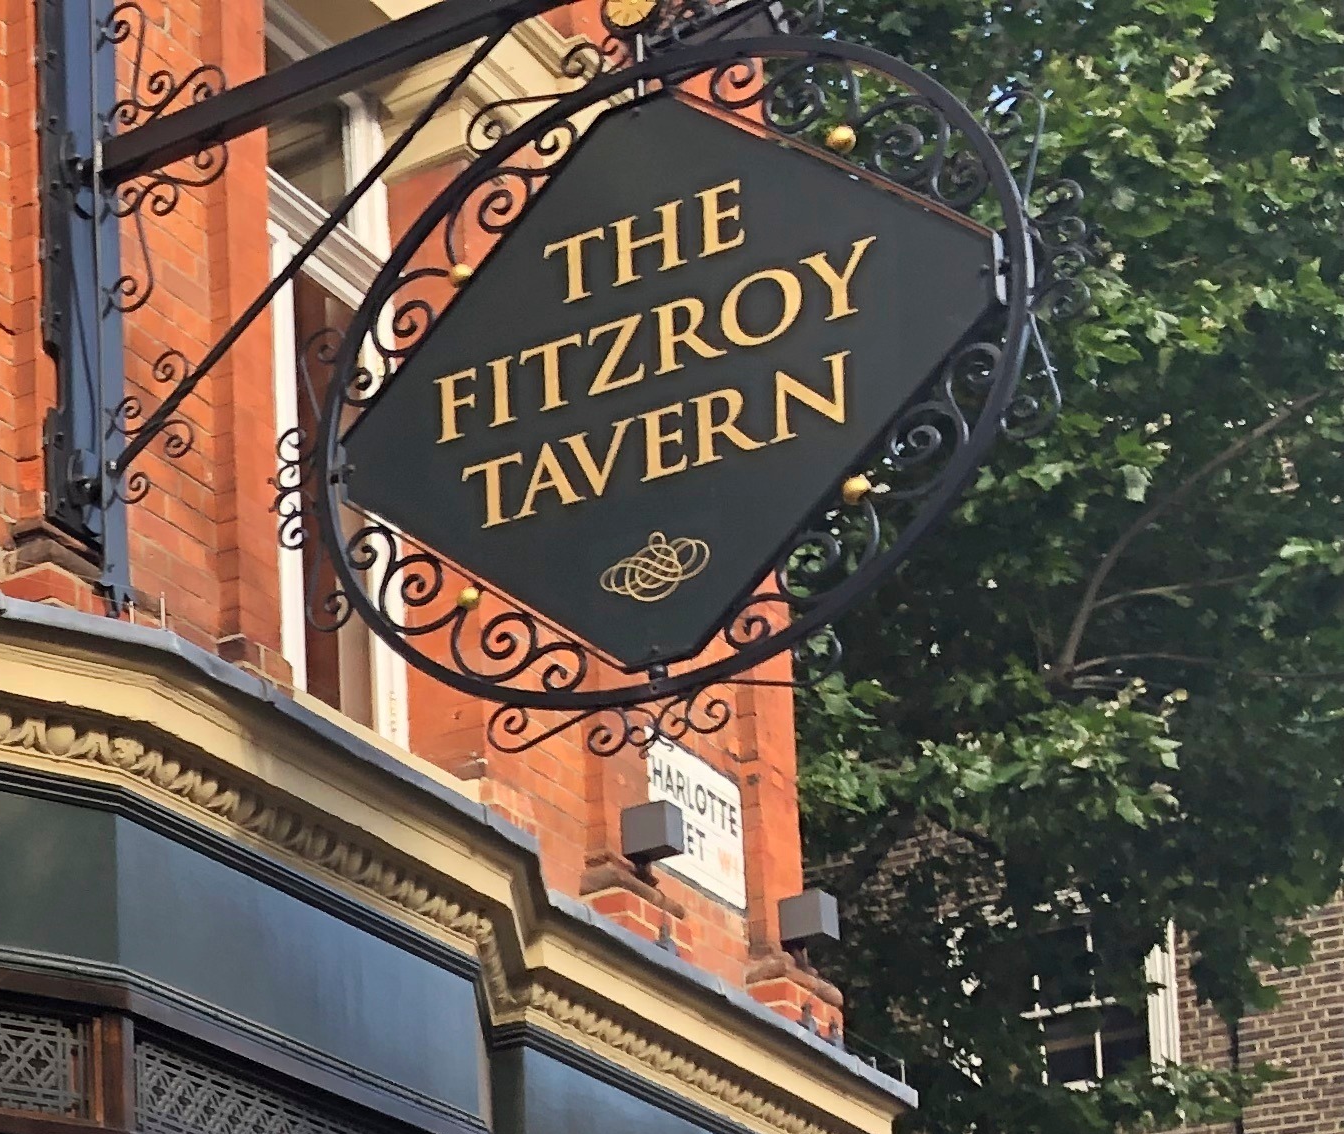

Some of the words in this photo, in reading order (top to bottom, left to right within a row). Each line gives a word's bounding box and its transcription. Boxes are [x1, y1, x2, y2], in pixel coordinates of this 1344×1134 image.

[543, 178, 747, 305] THE
[433, 235, 877, 445] FITZROY
[461, 350, 851, 530] TAVERN
[650, 755, 738, 838] HARLOTTE
